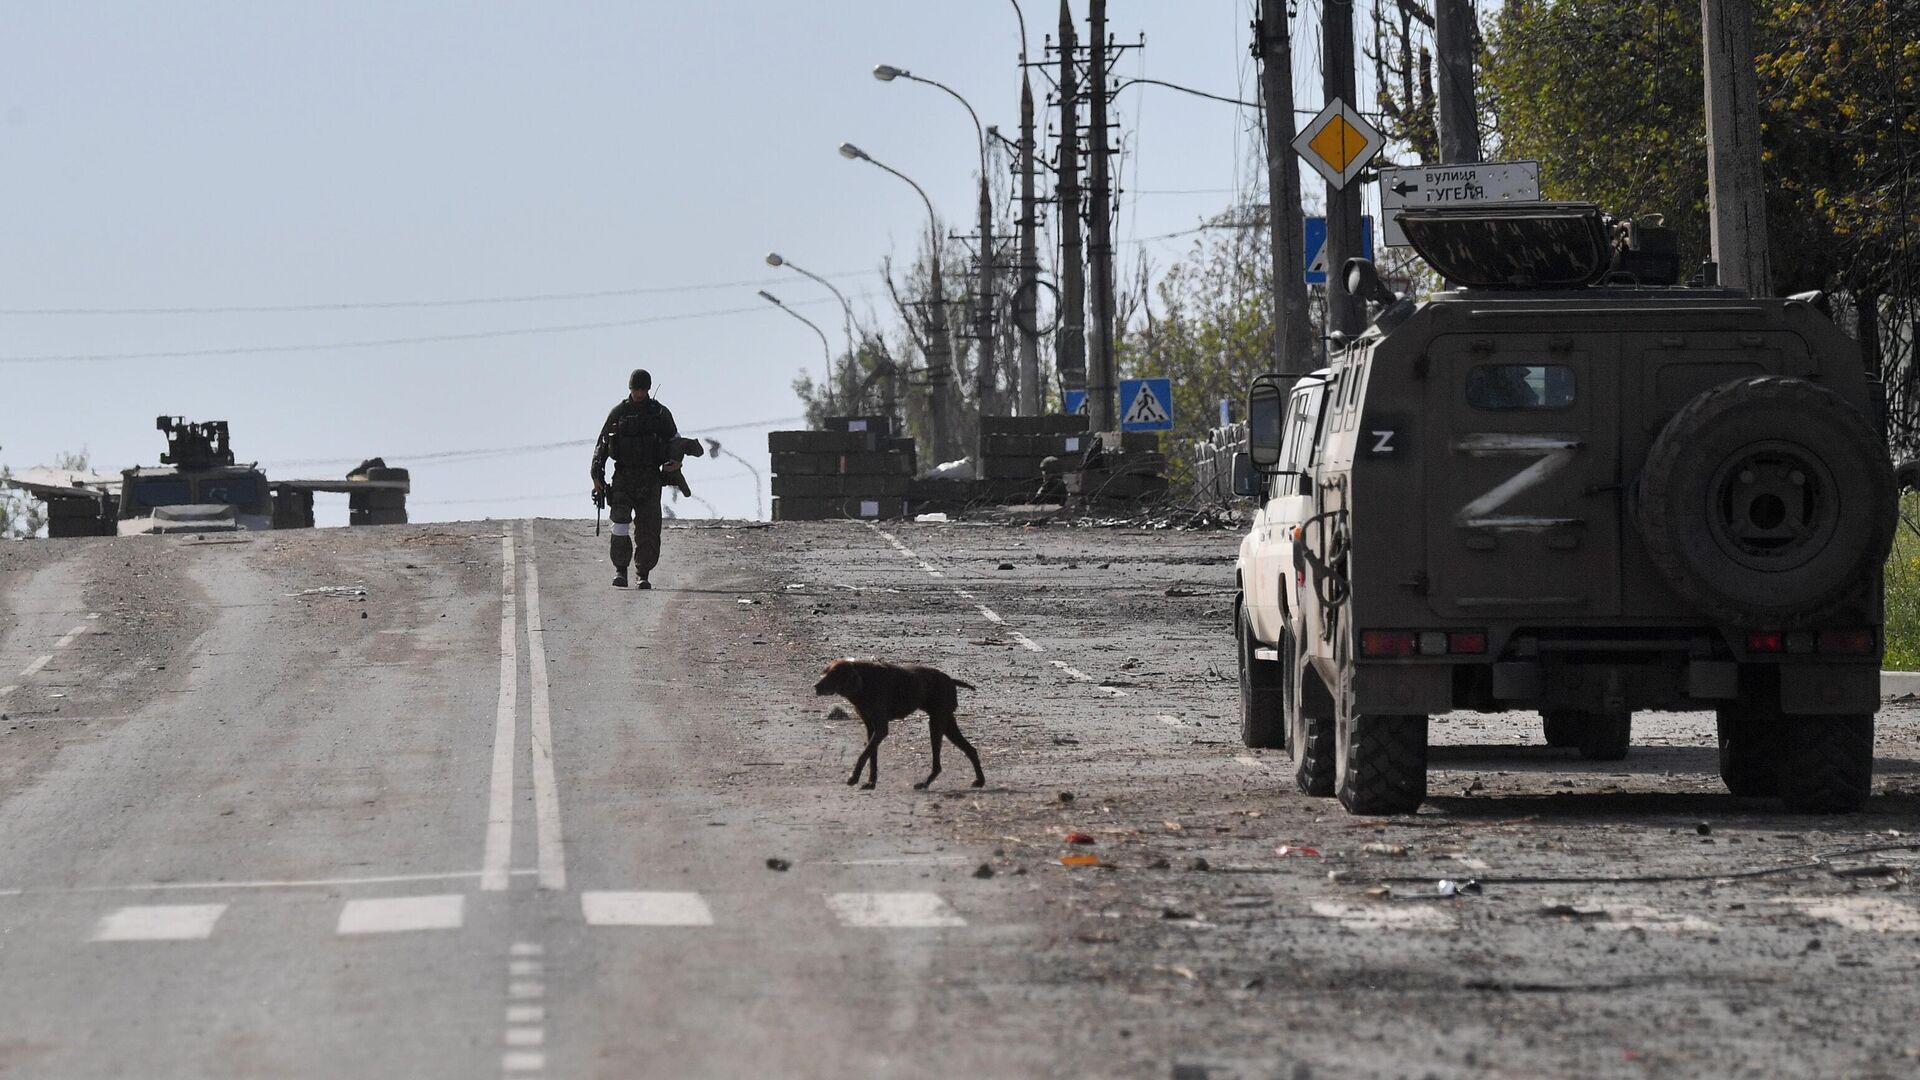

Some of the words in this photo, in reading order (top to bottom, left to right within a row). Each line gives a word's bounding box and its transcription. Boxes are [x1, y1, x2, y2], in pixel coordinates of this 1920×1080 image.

[1426, 170, 1476, 186] вулиця
[1371, 430, 1395, 452] Z
[1453, 432, 1582, 533] Z
